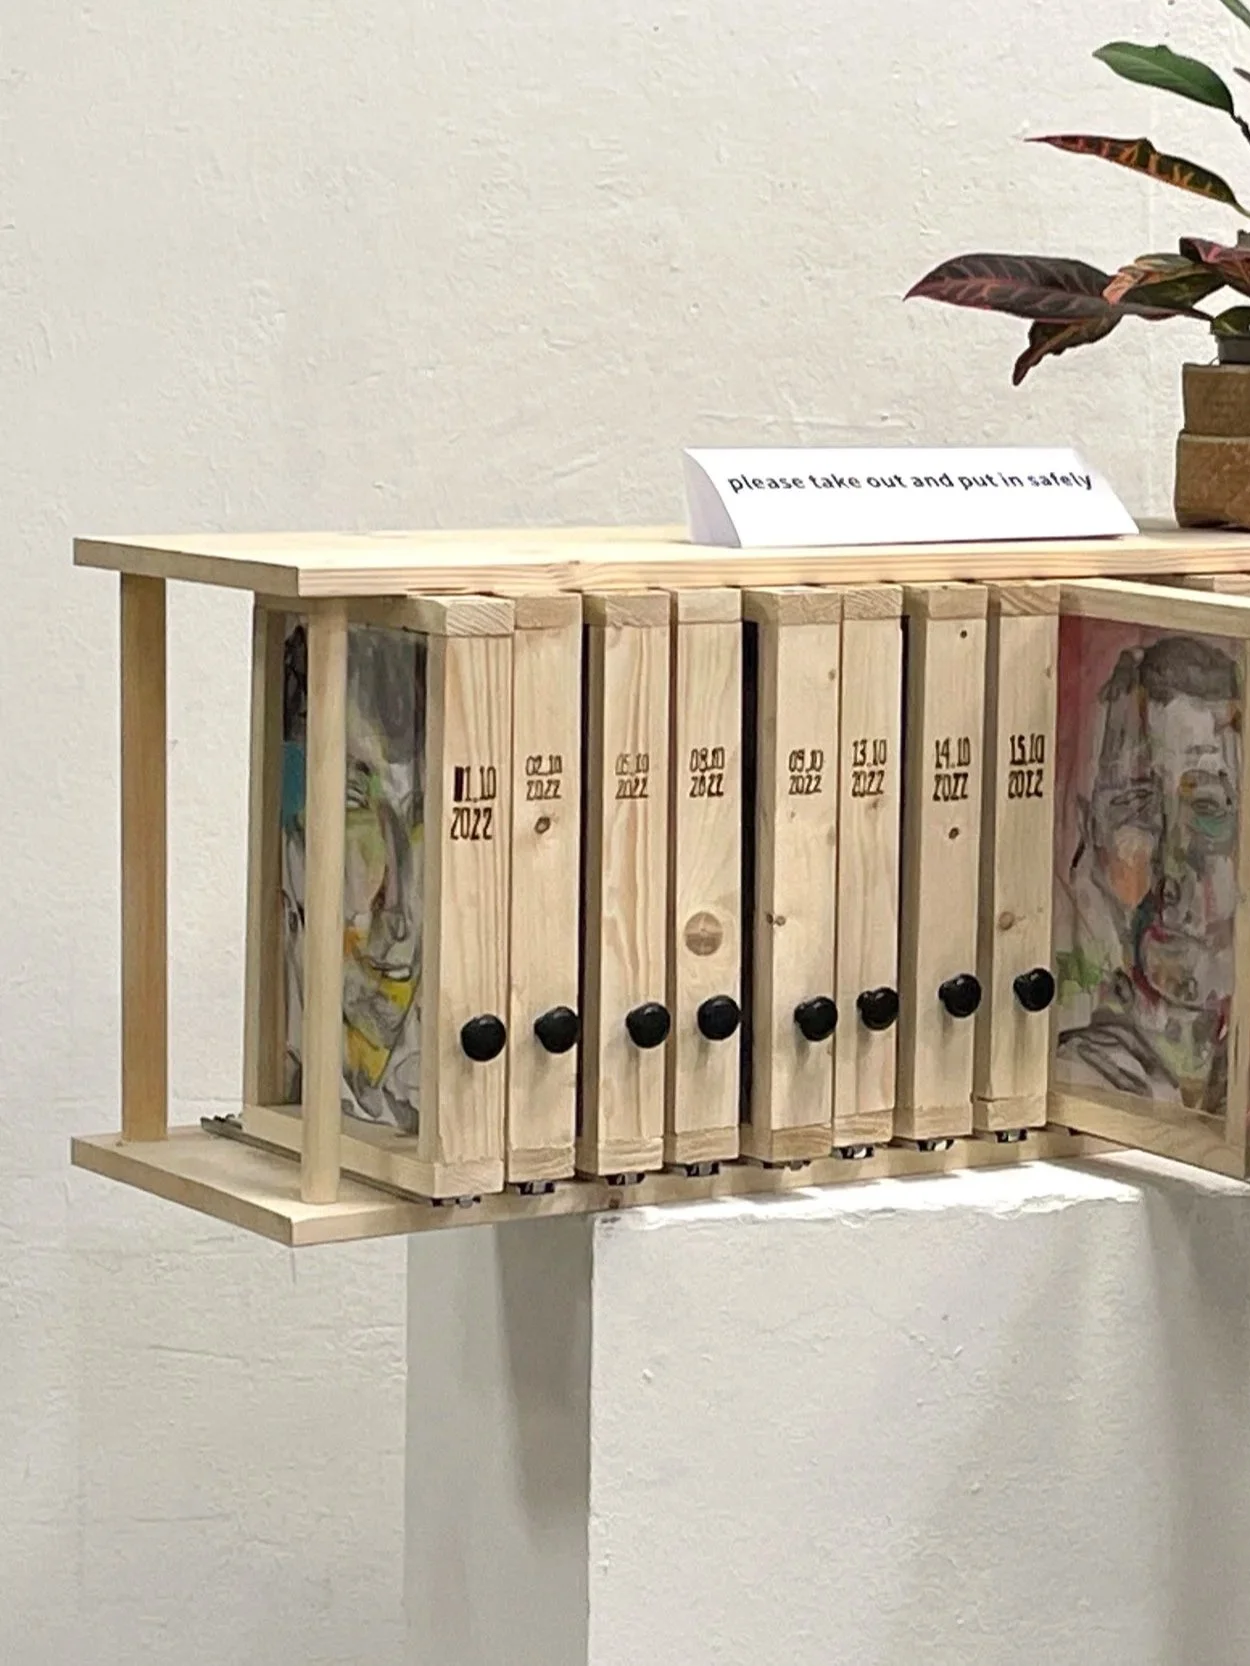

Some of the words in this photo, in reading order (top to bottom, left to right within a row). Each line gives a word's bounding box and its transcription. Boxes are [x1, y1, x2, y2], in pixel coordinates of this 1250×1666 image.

[728, 474, 805, 494] please
[808, 473, 862, 489] take
[866, 474, 907, 488] out
[910, 472, 954, 488] and
[958, 473, 998, 491] put
[998, 472, 1024, 487] in
[1027, 471, 1092, 491] safely
[852, 739, 887, 767] 13.10
[935, 737, 971, 769] 14.10
[526, 780, 562, 801] 2022
[615, 777, 648, 799] 2022
[689, 773, 724, 798] 2022
[788, 775, 822, 796] 2022
[852, 769, 885, 798] 2022
[933, 773, 969, 802] 2022
[1008, 768, 1043, 799] 2022
[450, 807, 492, 840] 2022
